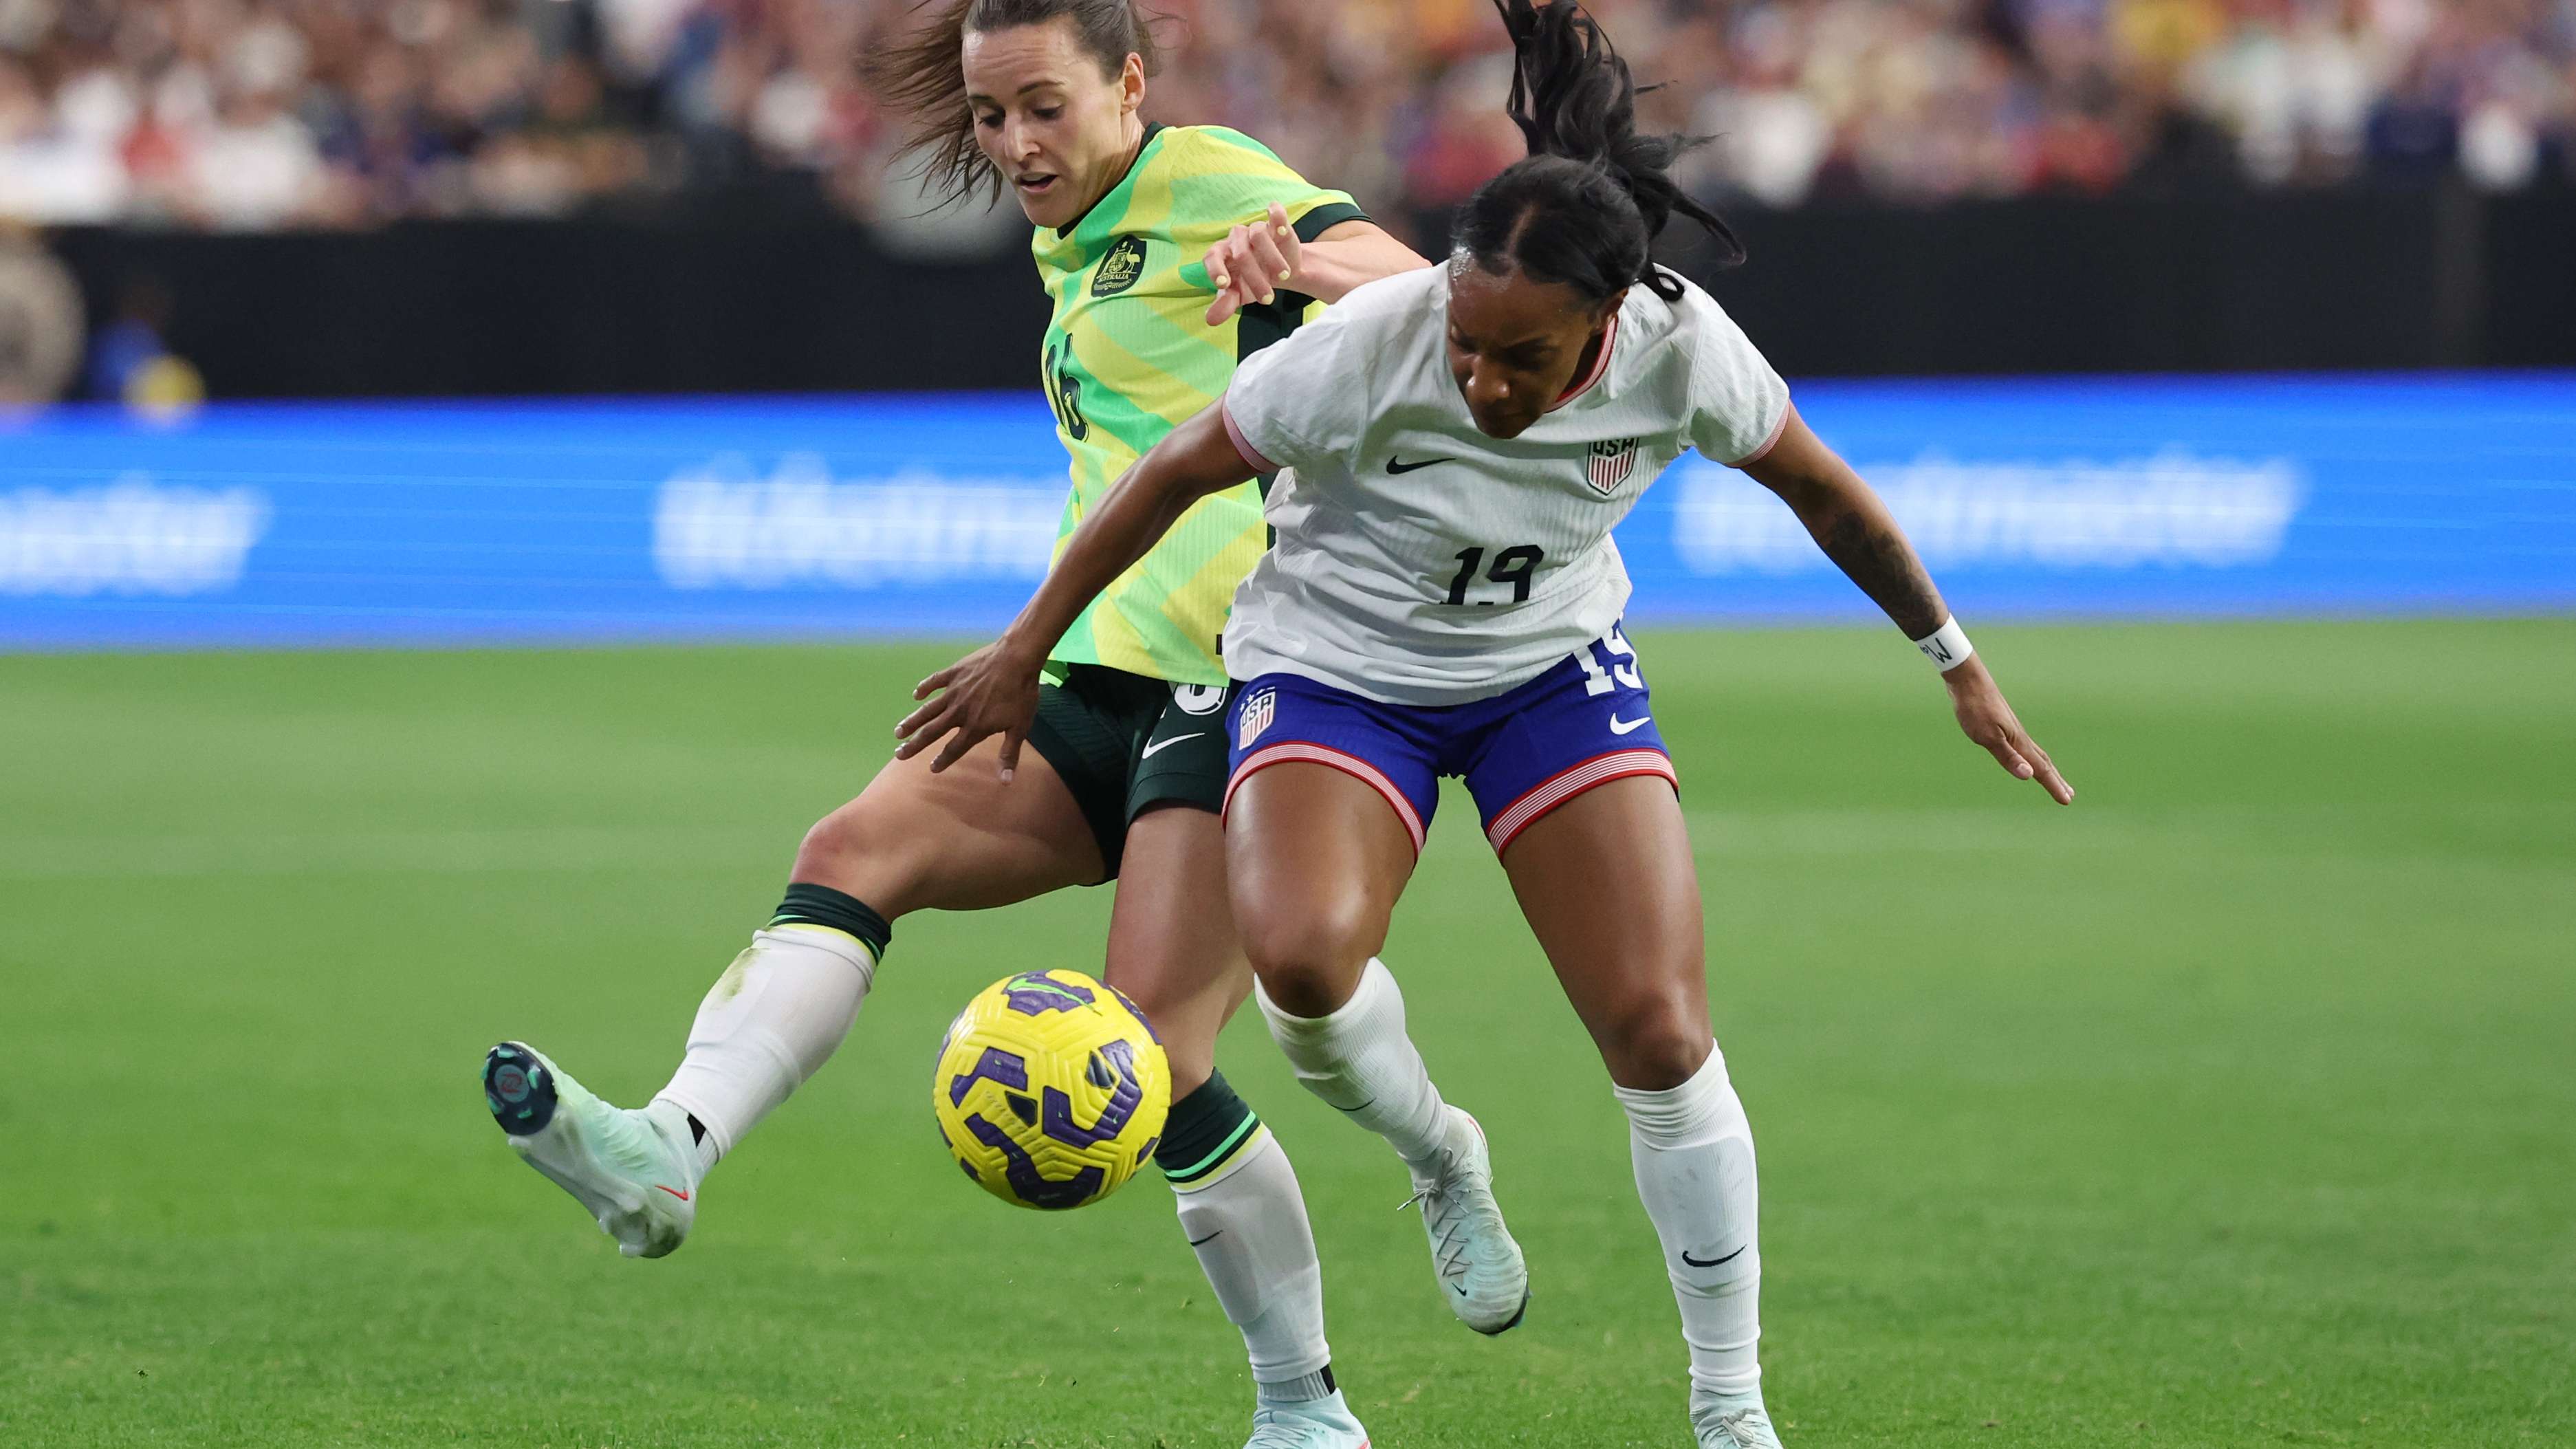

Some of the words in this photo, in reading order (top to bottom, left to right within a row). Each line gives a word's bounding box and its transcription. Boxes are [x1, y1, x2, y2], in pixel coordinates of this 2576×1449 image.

[1045, 332, 1089, 443] 16
[1593, 437, 1635, 457] USA
[1440, 544, 1544, 605] 19
[1242, 695, 1272, 727] USA
